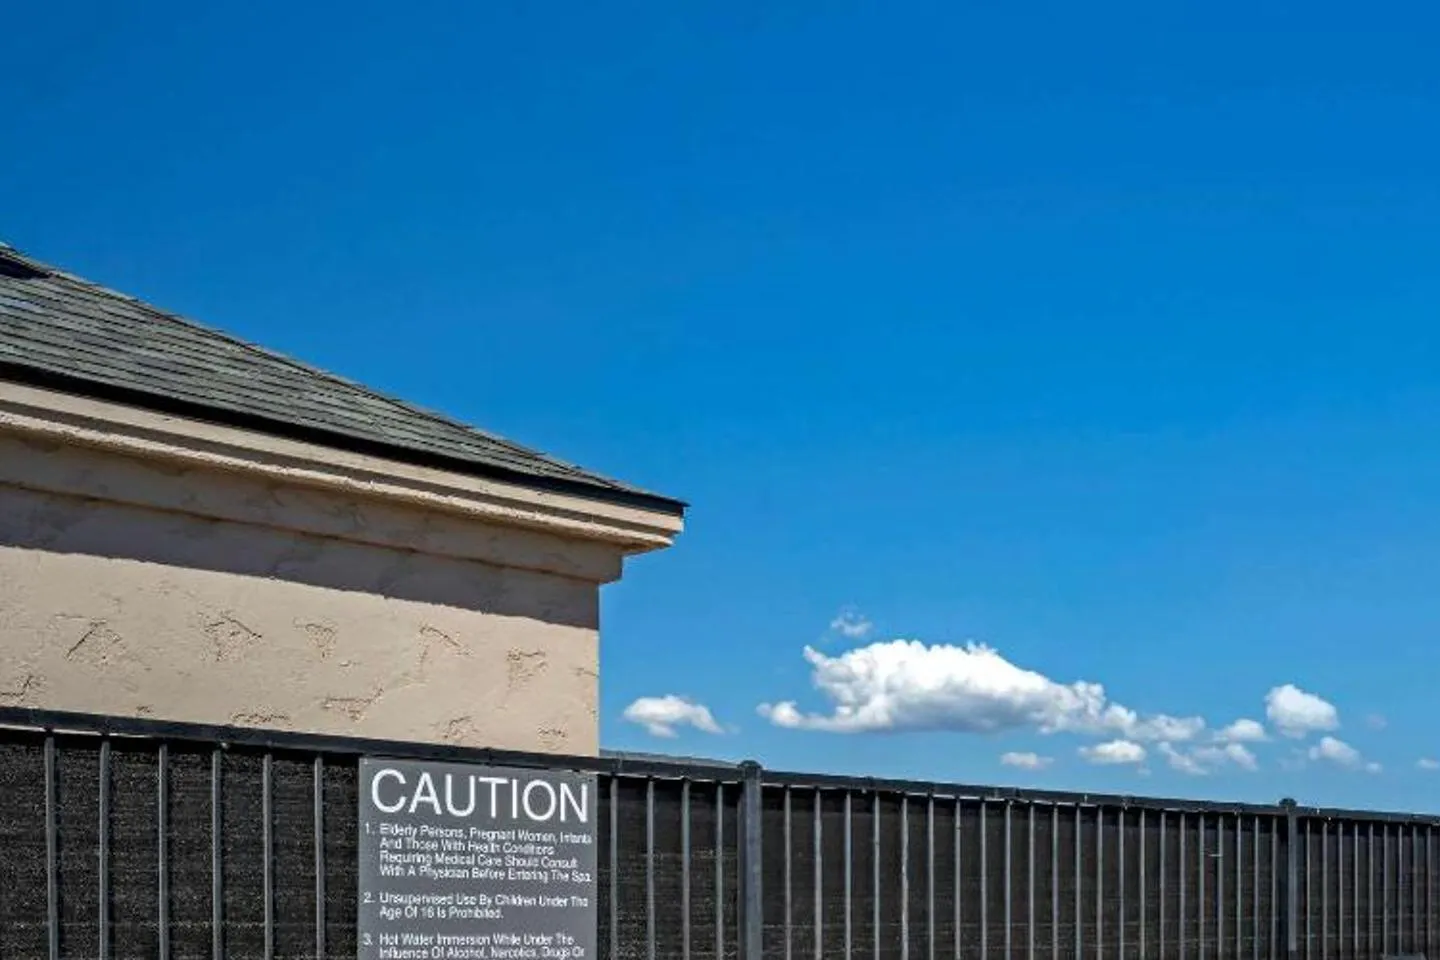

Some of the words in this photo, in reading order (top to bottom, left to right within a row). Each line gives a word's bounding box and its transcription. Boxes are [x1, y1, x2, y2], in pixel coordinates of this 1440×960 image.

[371, 769, 588, 823] CAUTION
[380, 823, 417, 841] Elderly
[420, 825, 468, 840] Persons,
[470, 827, 516, 843] Pregnant
[518, 829, 557, 845] Women,
[380, 837, 402, 850] And
[406, 837, 438, 851] Those
[441, 839, 465, 851] With
[468, 840, 501, 853] Health
[380, 850, 432, 866] Requiring
[435, 852, 475, 865] Medical
[477, 854, 502, 867] Care
[504, 855, 539, 868] Should
[541, 856, 578, 869] Consult
[380, 864, 405, 877] With
[407, 865, 416, 876] A
[420, 865, 469, 881] Physician
[472, 866, 505, 880] Before
[508, 867, 548, 884] Entering
[551, 869, 569, 880] The
[379, 892, 453, 905] Unsupervised
[456, 892, 477, 906] Use
[479, 893, 492, 909] By
[494, 894, 536, 907] Children
[539, 895, 568, 908] Under
[571, 895, 588, 908] The
[380, 905, 402, 921] Age
[404, 905, 418, 919] Of
[436, 906, 446, 919] Is
[379, 932, 398, 946] Hot
[400, 932, 434, 946] Water
[437, 932, 490, 946] Immersion
[492, 931, 521, 945] While
[523, 931, 553, 946] Under
[555, 931, 575, 945] The
[379, 946, 429, 960] Influence
[431, 946, 445, 959] Of
[541, 946, 571, 960] Drugs
[572, 945, 585, 958] Or
